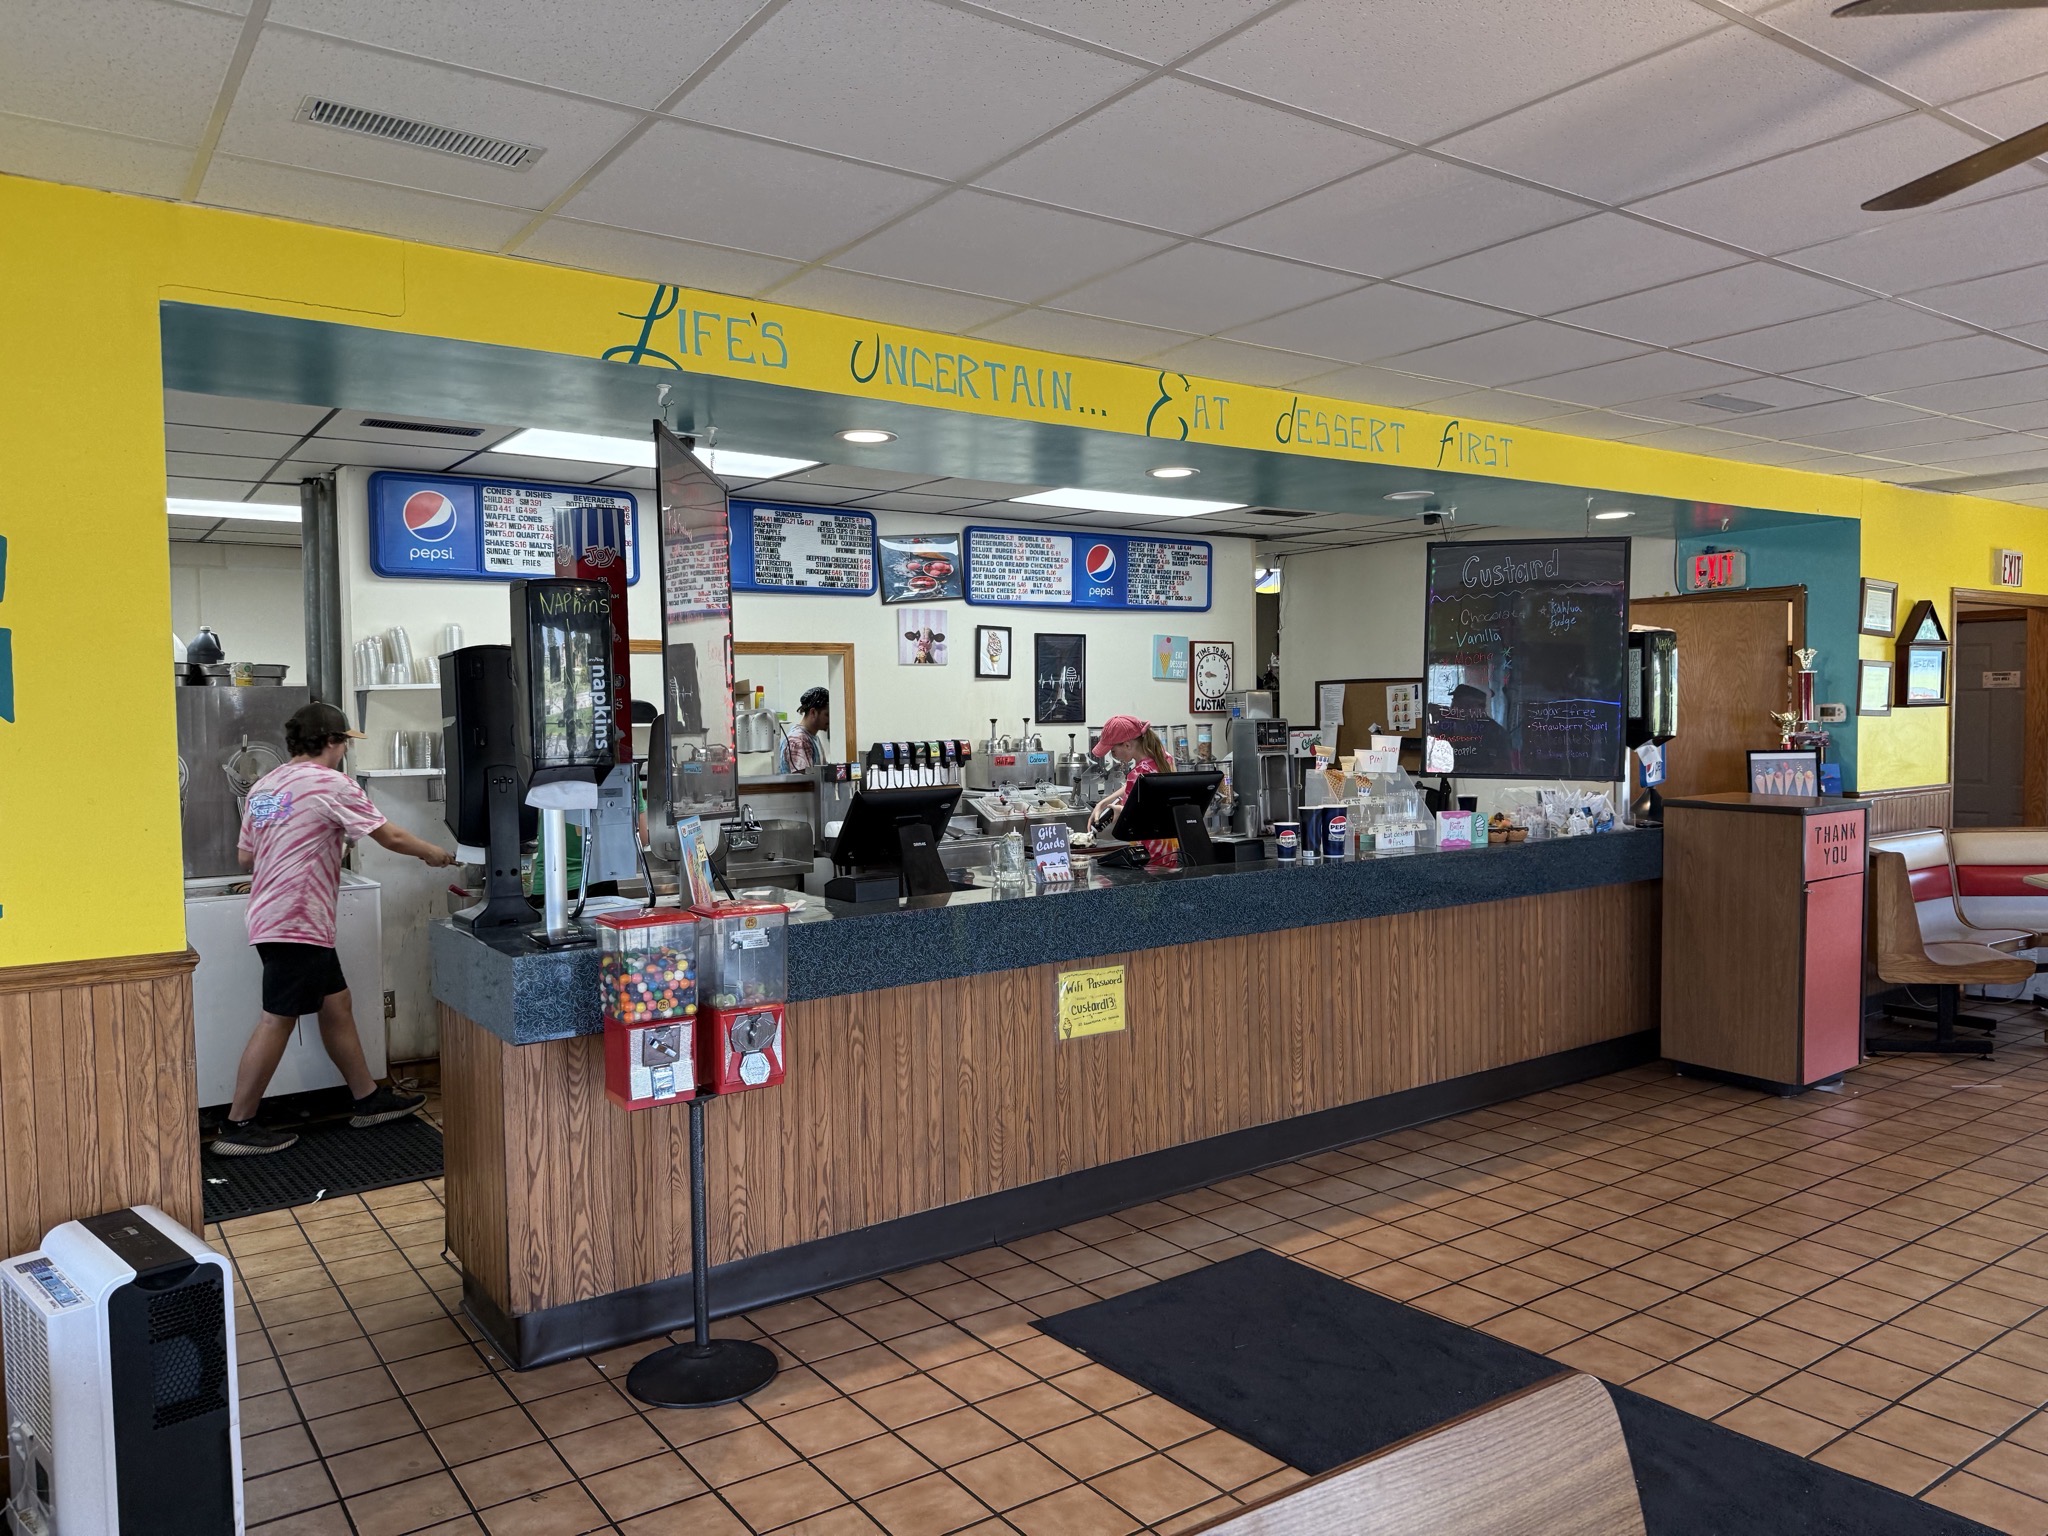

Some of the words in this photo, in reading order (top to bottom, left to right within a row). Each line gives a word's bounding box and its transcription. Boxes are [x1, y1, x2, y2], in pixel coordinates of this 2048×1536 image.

[602, 283, 788, 371] LIFE'S
[486, 487, 512, 496] CONES
[525, 491, 552, 499] DISHES
[573, 495, 615, 504] BEVERAGES
[484, 496, 503, 504] CHILD
[485, 513, 515, 521] WAFFLE
[518, 515, 543, 523] CONES
[485, 529, 502, 537] PINT
[755, 534, 786, 542] STRAWBERRY
[485, 539, 515, 548] SHAKES
[410, 547, 453, 562] pepsi
[538, 550, 554, 558] MONT
[522, 559, 541, 567] FRIES
[1462, 548, 1559, 588] Custard
[1695, 552, 1735, 587] EXIT
[2003, 554, 2021, 585] EXIT
[1089, 586, 1114, 597] pepsi
[1456, 630, 1502, 647] Vanilla
[1175, 651, 1183, 659] EAT
[1196, 647, 1210, 659] TIME
[1220, 649, 1231, 661] BUY
[589, 664, 612, 750] napkins
[1195, 698, 1226, 710] CUSTAR
[1532, 722, 1583, 731] Strawberry
[1038, 825, 1057, 840] Gift
[1815, 822, 1856, 844] THANK
[1036, 837, 1065, 852] Cards
[1824, 845, 1848, 865] YOU
[1087, 974, 1123, 989] Password
